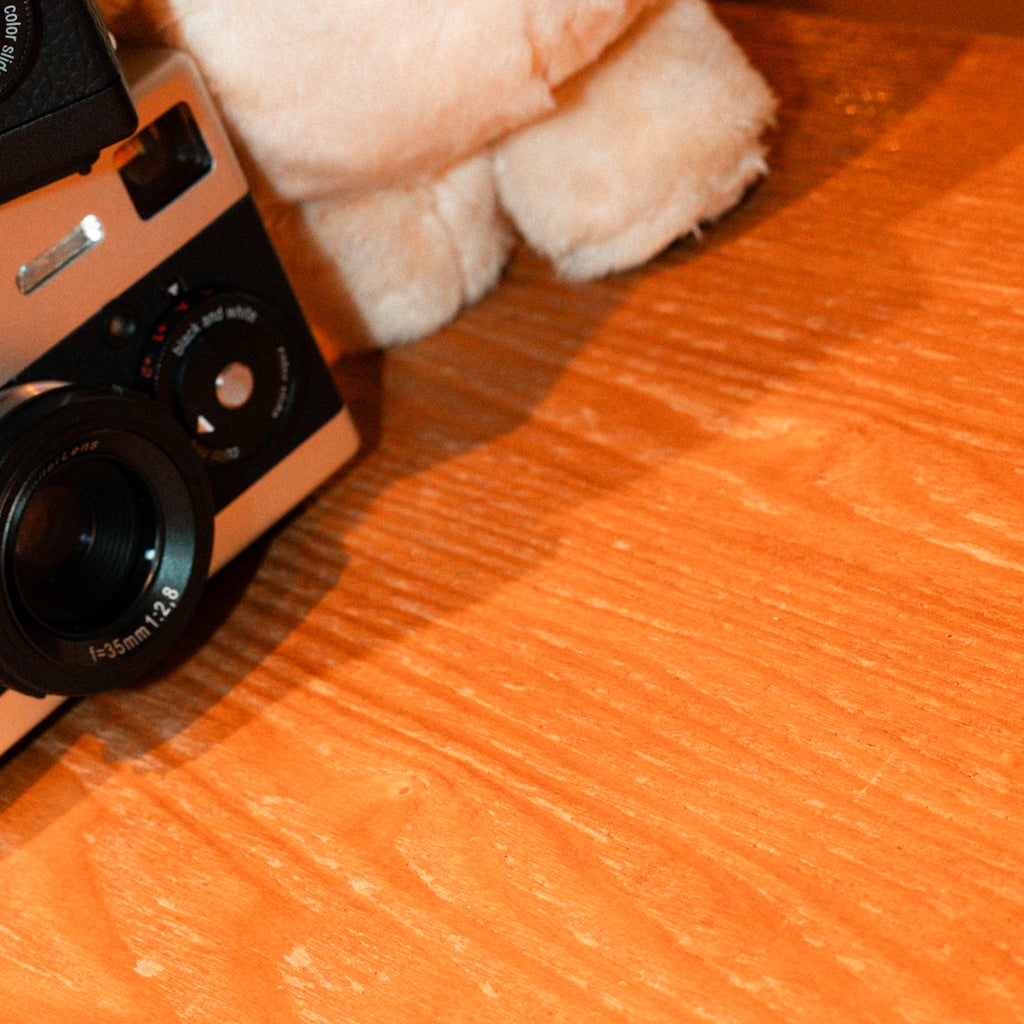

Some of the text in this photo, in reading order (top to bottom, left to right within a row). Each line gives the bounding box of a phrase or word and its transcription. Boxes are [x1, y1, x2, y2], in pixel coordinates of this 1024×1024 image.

[4, 4, 21, 42] color
[88, 586, 180, 662] f=35mm 1:2,8
